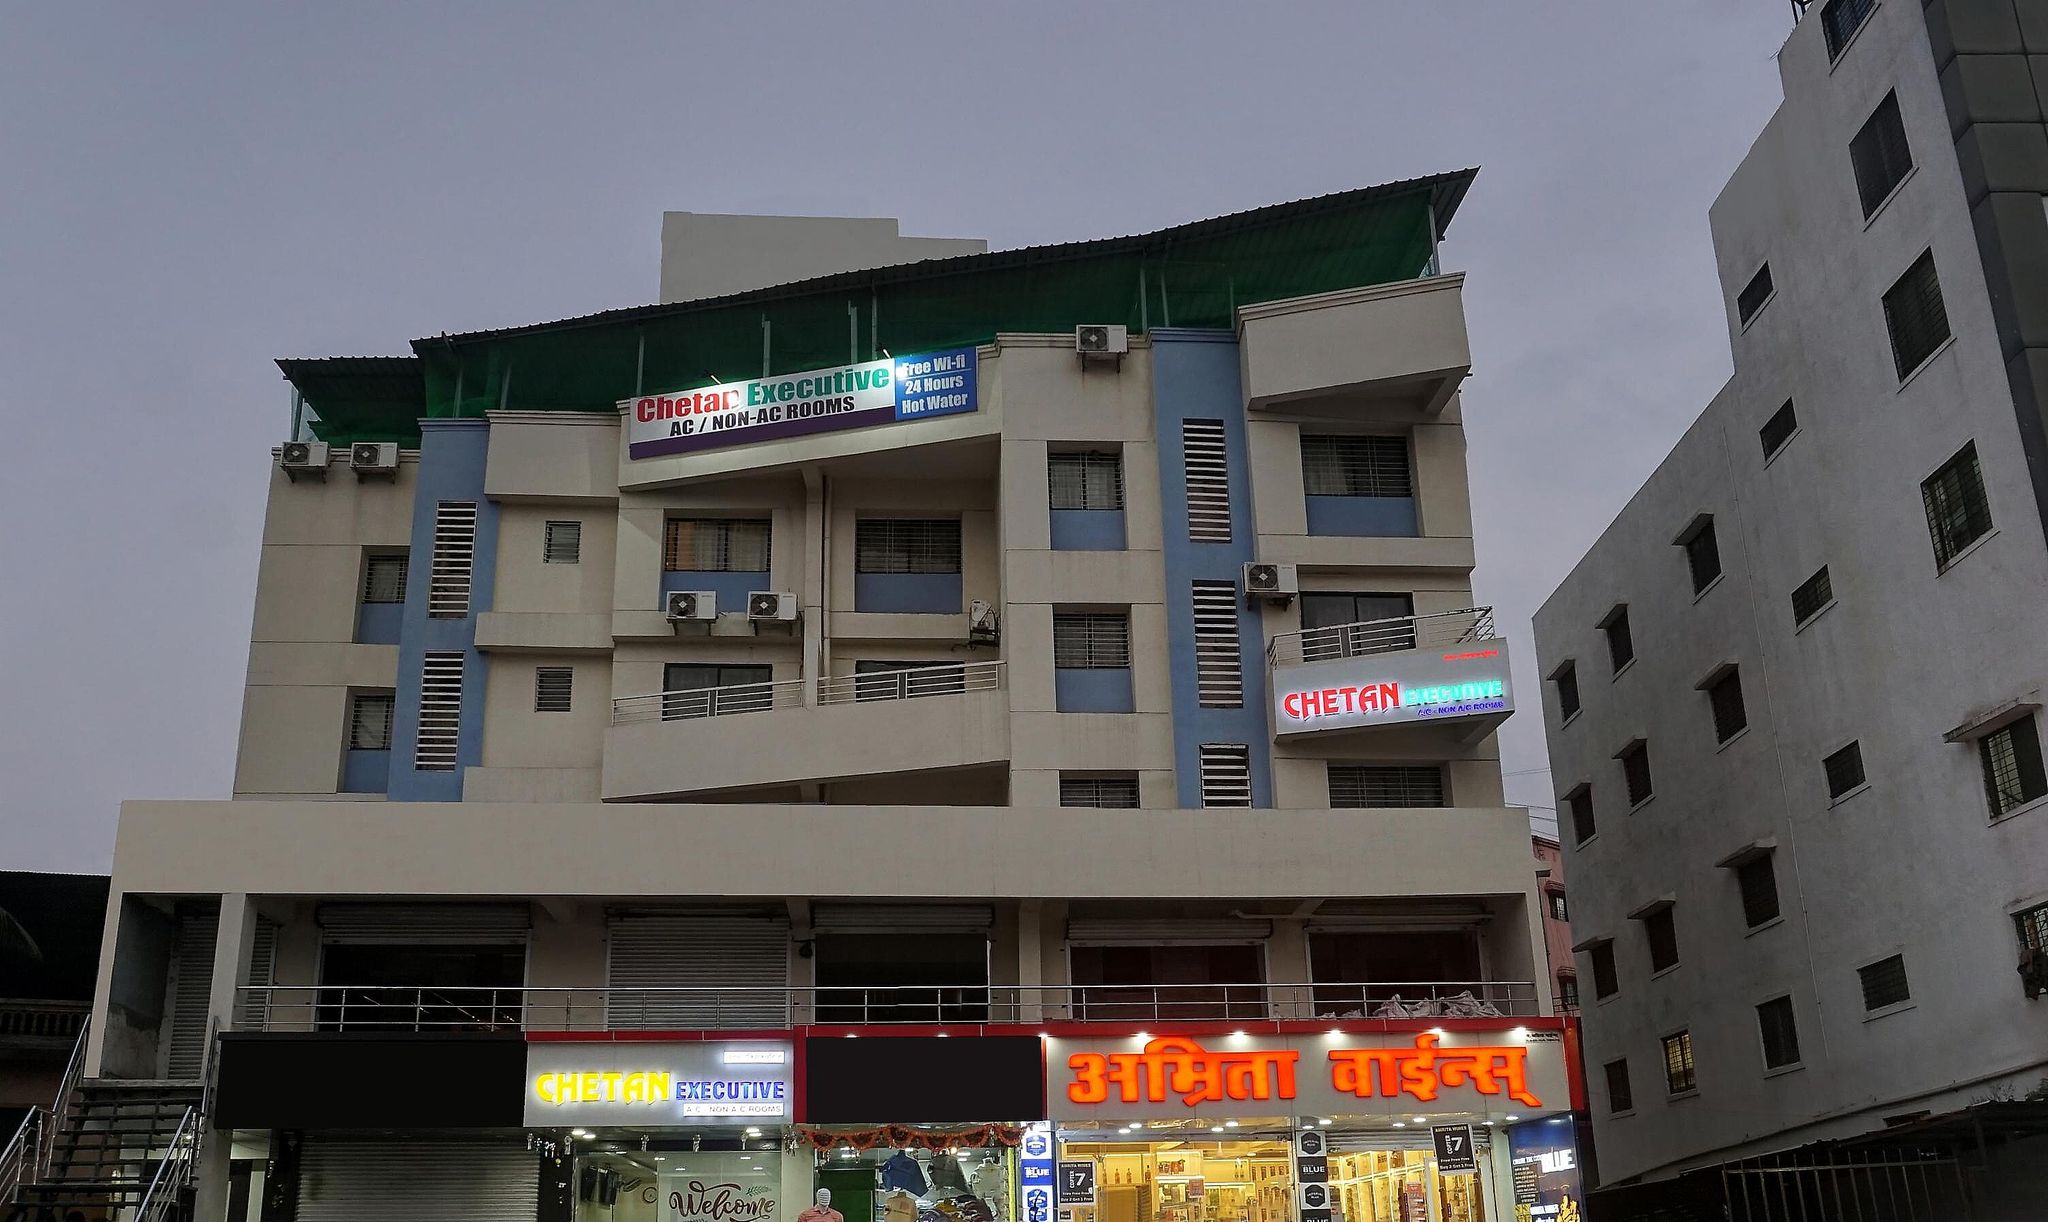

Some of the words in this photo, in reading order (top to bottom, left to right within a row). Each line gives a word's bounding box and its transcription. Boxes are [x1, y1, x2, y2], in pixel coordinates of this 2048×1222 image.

[901, 360, 932, 376] Free
[933, 354, 966, 373] Wi-fi
[637, 389, 740, 423] Chetan
[747, 366, 889, 406] Executive
[904, 380, 922, 395] 24
[923, 375, 964, 392] Hours
[902, 398, 924, 414] Hot
[926, 391, 968, 411] Water
[670, 418, 694, 437] AC
[698, 417, 706, 434] /
[712, 406, 782, 431] NON-AC
[786, 395, 855, 419] ROOMS
[1284, 682, 1401, 722] CHETAN
[1404, 680, 1504, 707] EXECUTIVE
[1438, 706, 1457, 715] NON
[1068, 1037, 1299, 1107] अम्रिता
[536, 1071, 671, 1106] CHETAN
[675, 1081, 784, 1101] EXECUTIVE
[1451, 1136, 1463, 1151] 7
[1075, 1173, 1086, 1186] 7
[669, 1180, 776, 1221] Welcome
